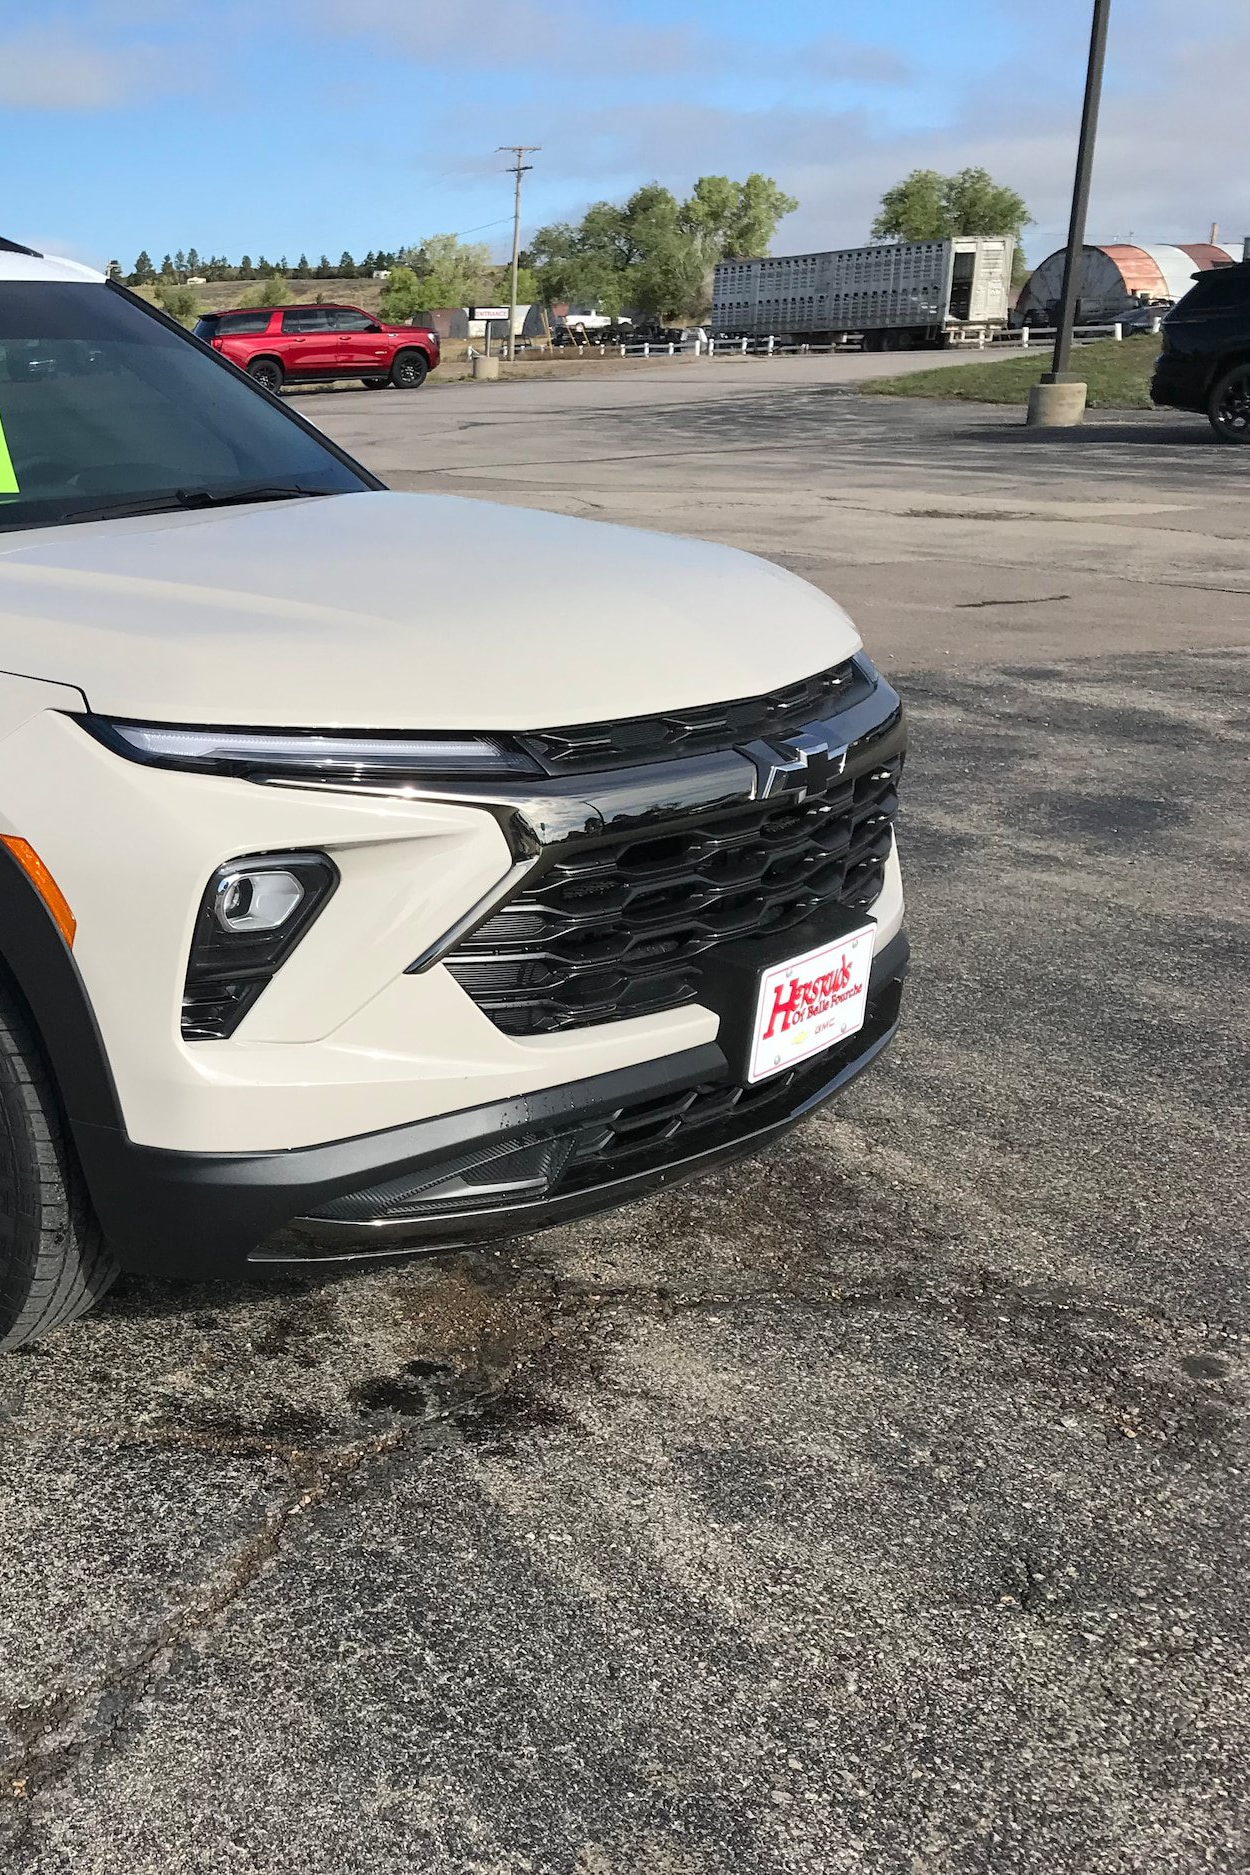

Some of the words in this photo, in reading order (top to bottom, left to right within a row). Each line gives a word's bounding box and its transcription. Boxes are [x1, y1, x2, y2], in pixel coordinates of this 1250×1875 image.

[476, 310, 508, 318] ENTRANCE
[792, 1008, 806, 1026] Of
[806, 1000, 830, 1019] Belle
[830, 983, 863, 1009] Fourche
[815, 1017, 836, 1034] GMC
